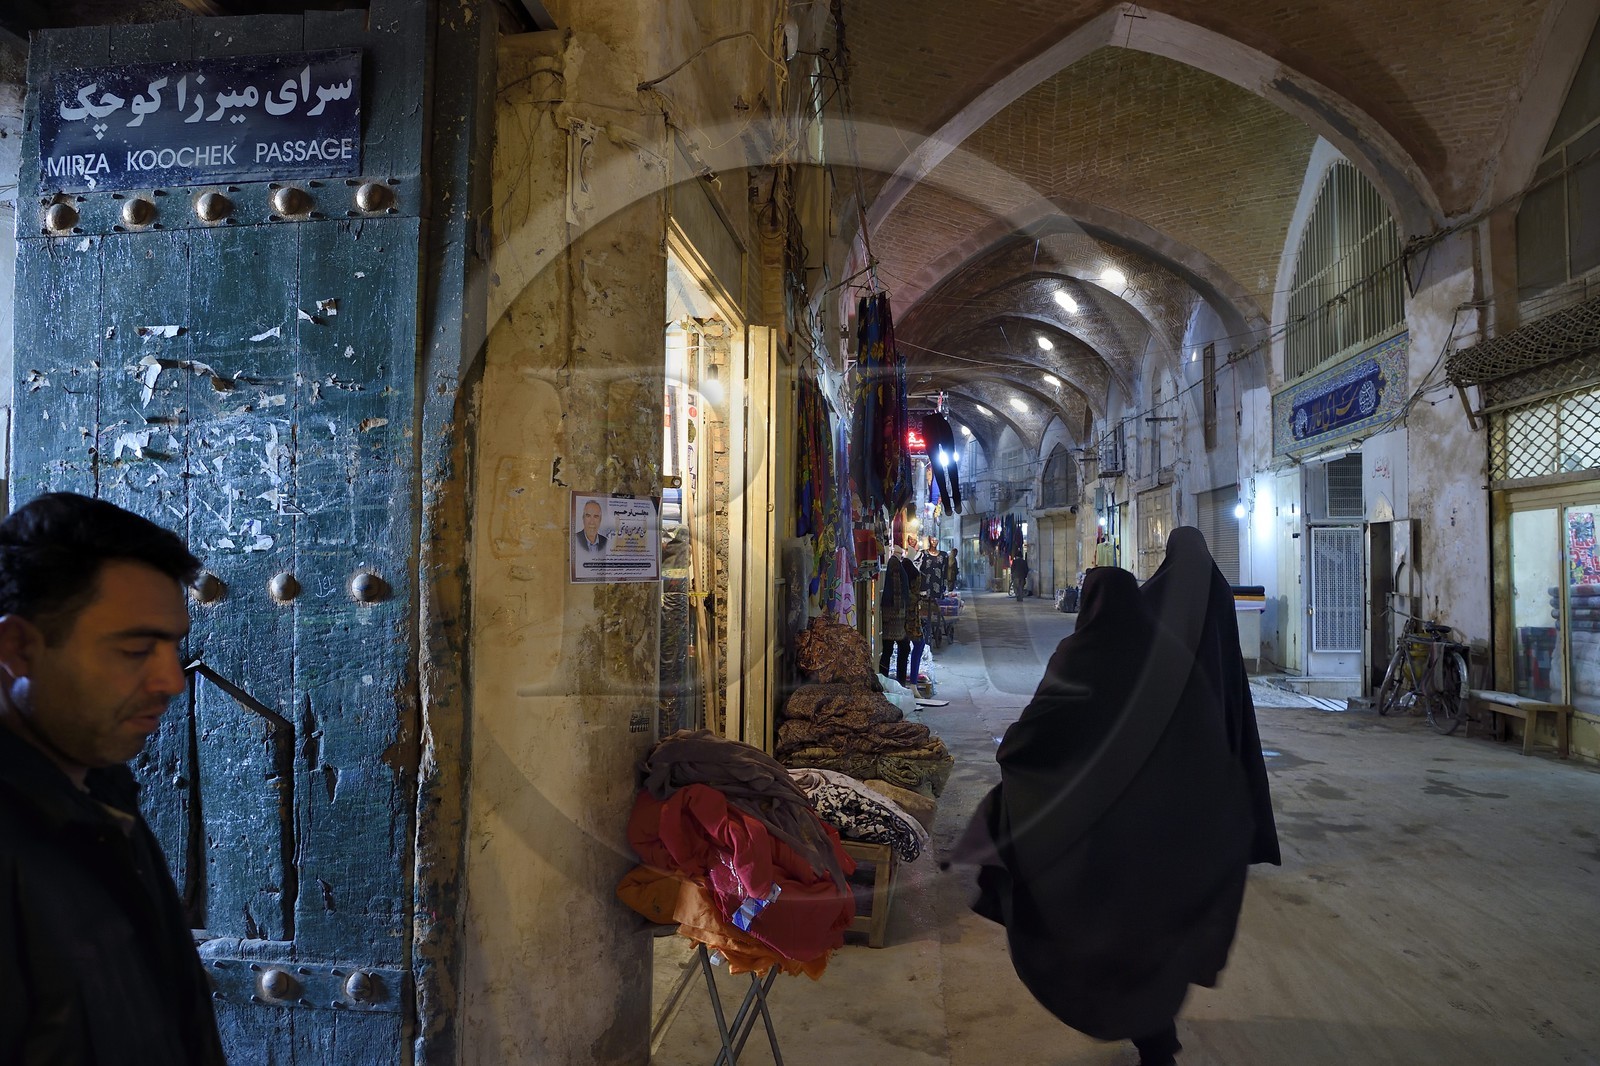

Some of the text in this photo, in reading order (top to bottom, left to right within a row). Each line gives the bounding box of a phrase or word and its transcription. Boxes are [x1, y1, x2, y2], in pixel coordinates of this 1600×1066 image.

[59, 65, 353, 141] سرای میرزا کوچک
[47, 138, 353, 177] MIRZA KOOCHEK PASSAGE
